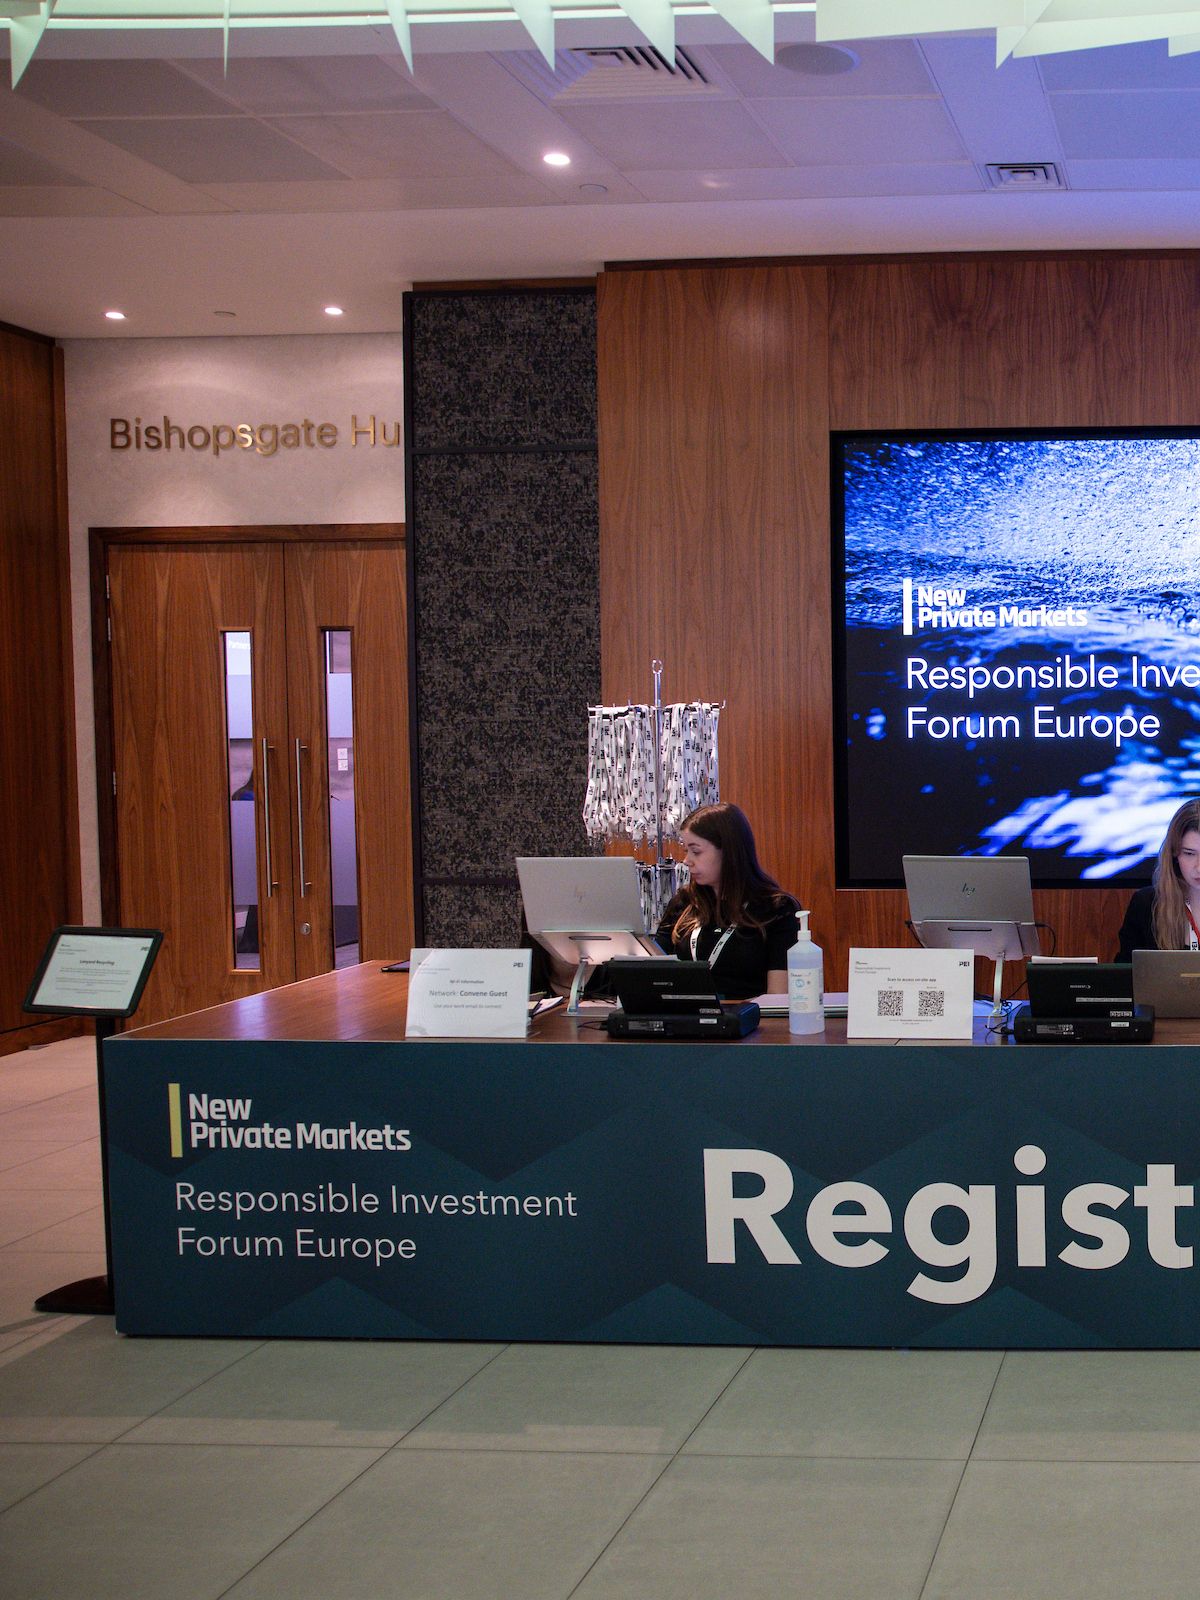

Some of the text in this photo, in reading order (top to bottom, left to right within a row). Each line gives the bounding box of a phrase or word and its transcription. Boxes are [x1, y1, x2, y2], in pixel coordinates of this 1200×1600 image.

[110, 414, 401, 457] Bishopsgate Hu
[917, 585, 967, 607] New
[917, 604, 1088, 628] Private Markets
[905, 655, 1120, 698] Responsible
[905, 705, 1161, 747] Forum Europe
[188, 1092, 253, 1121] New
[190, 1118, 412, 1152] Private Markets
[174, 1182, 578, 1220] Responsible Investment
[177, 1227, 418, 1266] Forum Europe
